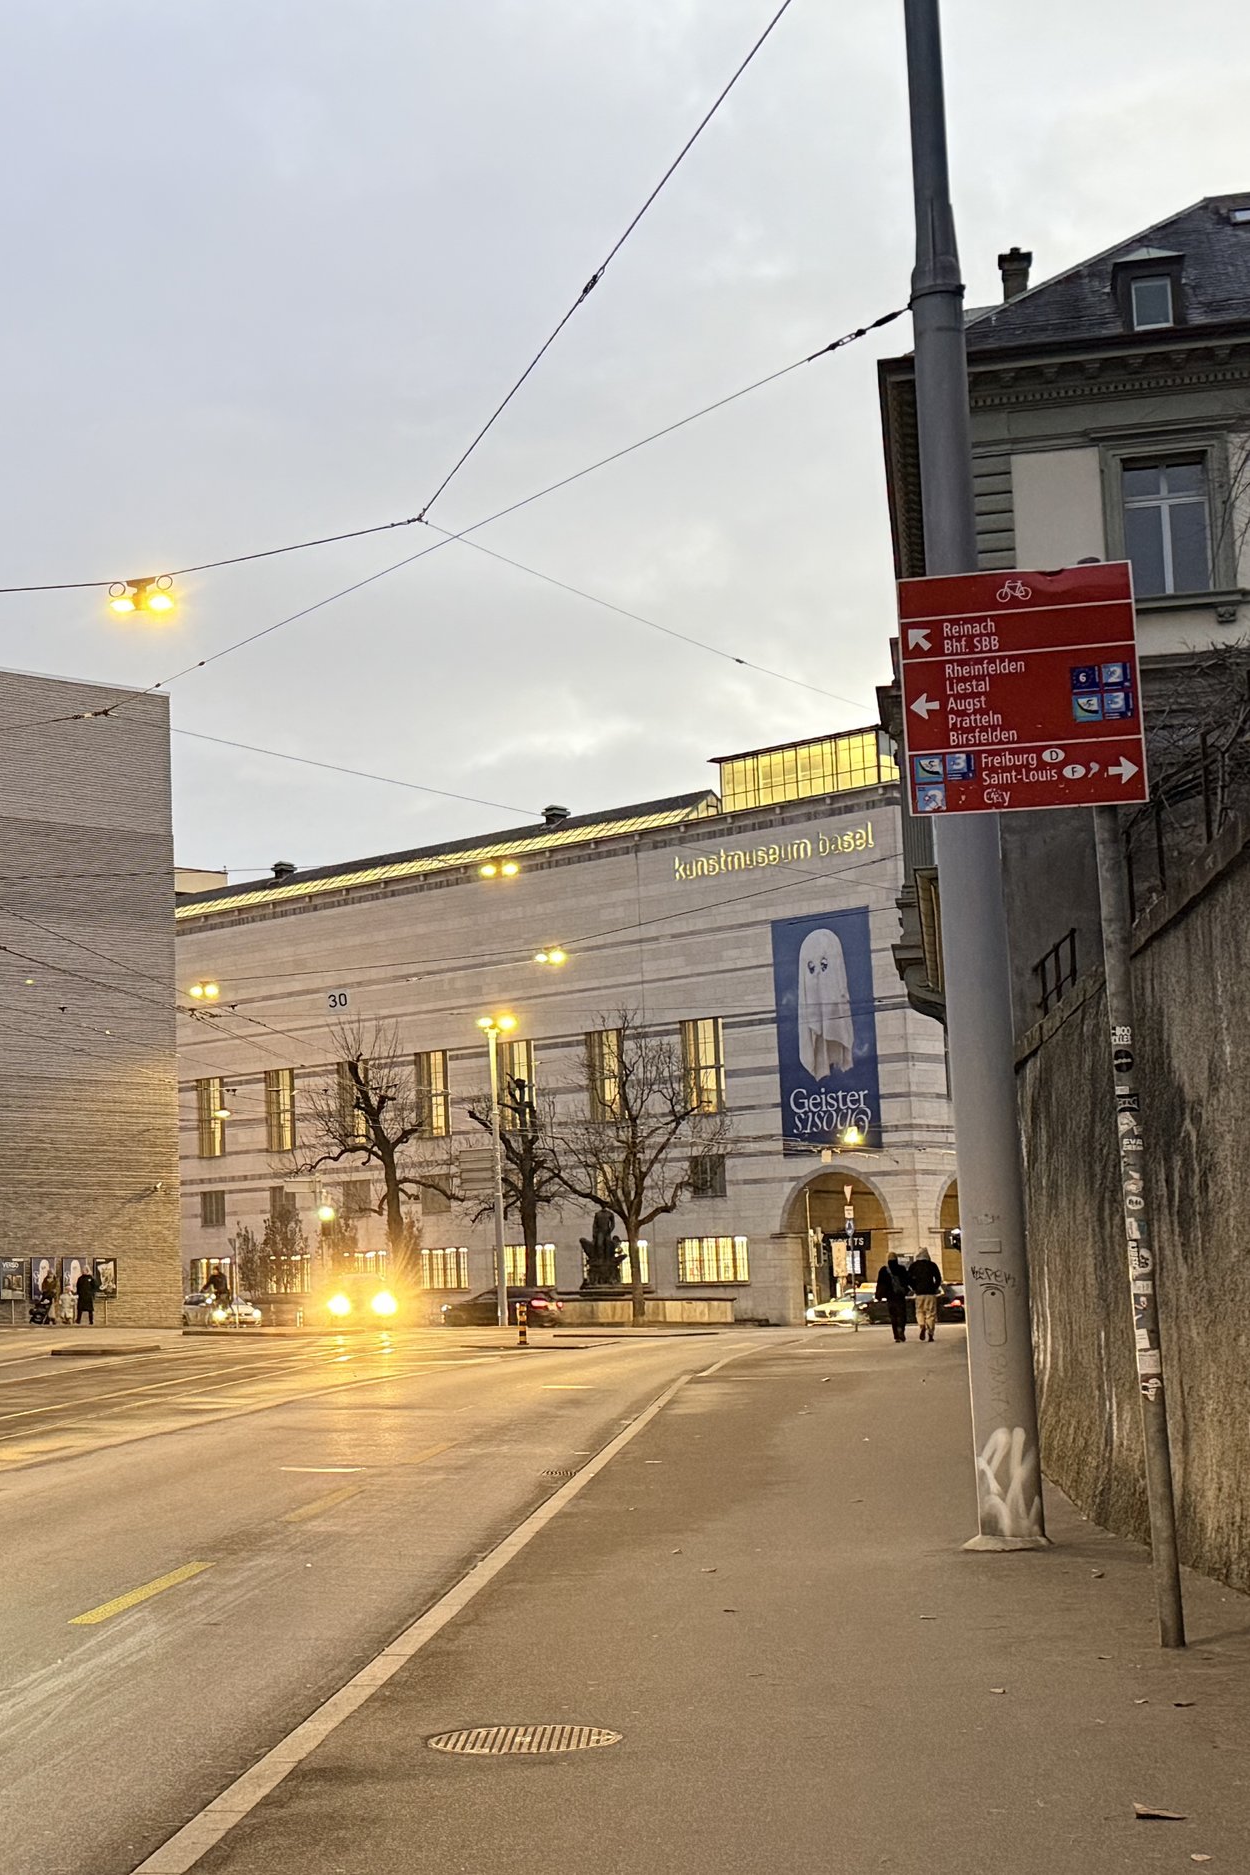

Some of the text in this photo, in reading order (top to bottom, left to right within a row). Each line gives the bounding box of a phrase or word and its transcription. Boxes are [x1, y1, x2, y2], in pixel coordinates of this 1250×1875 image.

[943, 618, 996, 636] Reinach
[944, 636, 1000, 654] Bhf. SBB
[945, 659, 1025, 678] Rheinfelden
[1079, 672, 1087, 683] 6
[946, 677, 990, 694] Liestal
[947, 695, 987, 713] Augst
[948, 711, 1002, 729] Pratteln
[950, 728, 1018, 746] Birsfelden
[981, 750, 1059, 772] Freiburg D
[982, 766, 1079, 785] Saint-Louis F
[674, 821, 875, 881] kunstmuseum basel
[327, 993, 347, 1008] 30
[790, 1087, 869, 1114] Geister
